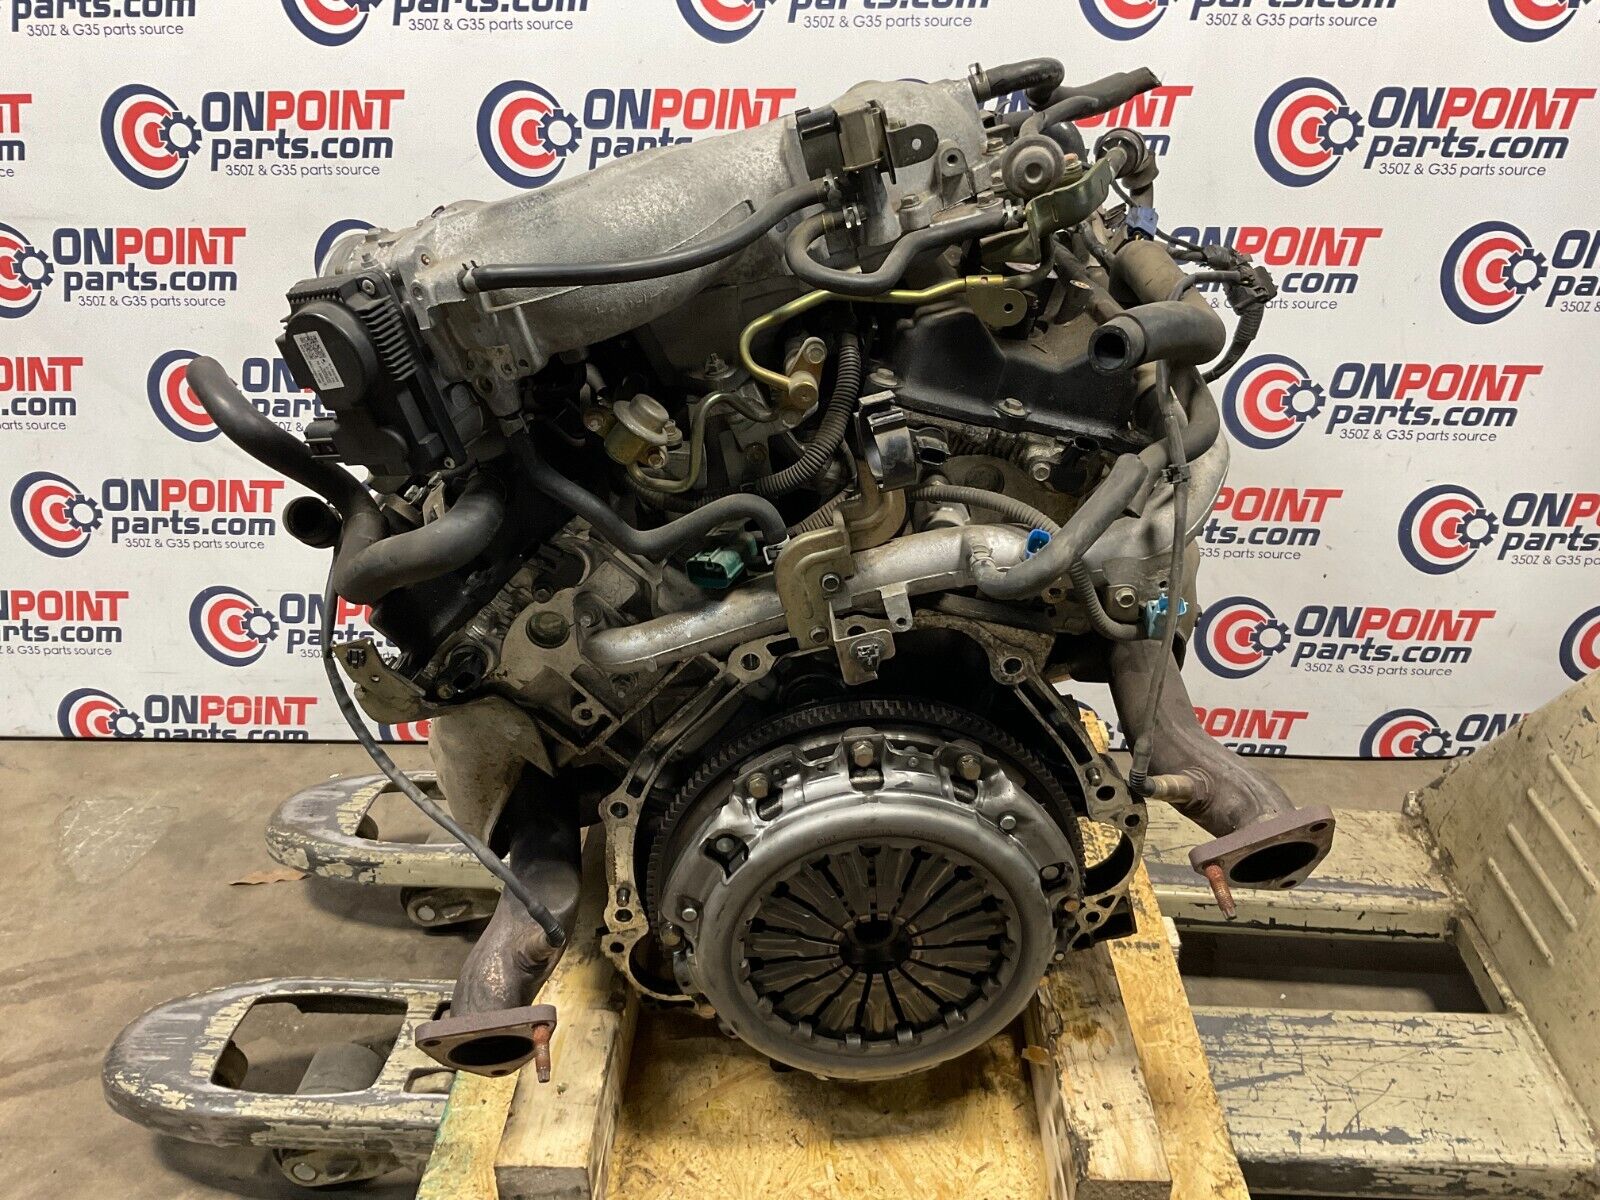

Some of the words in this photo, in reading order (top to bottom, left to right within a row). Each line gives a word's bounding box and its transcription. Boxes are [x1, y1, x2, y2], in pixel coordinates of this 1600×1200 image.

[27, 24, 56, 36] 350Z
[60, 25, 69, 35] &
[73, 24, 99, 35] G35
[103, 23, 136, 37] parts
[140, 25, 183, 34] source
[409, 19, 439, 30] 350Z
[443, 19, 453, 30] &
[457, 18, 485, 30] G35
[489, 18, 523, 32] parts
[527, 20, 573, 30] source
[804, 16, 834, 28] 350Z
[839, 16, 849, 27] &
[853, 15, 881, 27] G35
[886, 14, 920, 29] parts
[925, 17, 972, 27] source
[1206, 13, 1238, 25] 350Z
[1241, 14, 1251, 26] &
[1256, 14, 1285, 26] G35
[1289, 14, 1324, 28] parts
[1329, 17, 1377, 26] source
[201, 89, 405, 132] ONPOINT
[583, 88, 797, 130] ONPOINT
[1368, 87, 1597, 130] ONPOINT
[210, 128, 393, 171] parts.com
[1363, 127, 1569, 170] parts.com
[226, 164, 254, 176] 350Z
[258, 165, 268, 176] &
[270, 164, 297, 175] G35
[301, 164, 332, 177] parts
[336, 166, 379, 175] source
[1379, 163, 1410, 174] 350Z
[1414, 163, 1424, 175] &
[1429, 163, 1457, 175] G35
[1460, 164, 1495, 178] parts
[1499, 167, 1546, 176] source
[52, 227, 246, 265] ONPOINT
[63, 262, 238, 302] parts.com
[78, 296, 106, 306] 350Z
[109, 295, 119, 307] &
[122, 296, 147, 306] G35
[151, 296, 181, 308] parts
[184, 298, 225, 306] source
[1264, 298, 1288, 309] arts
[1292, 301, 1337, 309] source
[1560, 301, 1591, 312] 350Z
[1329, 362, 1544, 401] ONPOINT
[0, 421, 23, 430] arts
[26, 422, 66, 430] source
[1325, 397, 1518, 435] parts.com
[1340, 429, 1369, 439] 350Z
[1373, 429, 1382, 440] &
[1387, 430, 1413, 440] G35
[1416, 431, 1449, 442] parts
[1452, 433, 1496, 441] source
[102, 478, 285, 513] ONPOINT
[1212, 487, 1344, 523] POINT
[112, 509, 276, 544] parts.com
[1204, 518, 1320, 546] ts.com
[125, 538, 151, 547] 350Z
[155, 538, 163, 548] &
[166, 539, 190, 548] G35
[193, 539, 222, 549] parts
[225, 541, 264, 549] source
[1223, 549, 1254, 559] parts
[1258, 551, 1301, 559] source
[1511, 555, 1540, 564] 350Z
[1542, 555, 1551, 565] &
[1556, 555, 1581, 565] G35
[0, 590, 129, 621] POINT
[0, 619, 122, 642] rts.com
[1294, 605, 1497, 641] ONPOINT
[6, 646, 14, 654] &
[17, 646, 40, 654] G35
[43, 646, 71, 656] parts
[1291, 637, 1472, 667] parts.com
[1305, 662, 1333, 672] 350Z
[1336, 663, 1345, 673] &
[1349, 665, 1374, 674] G35
[1377, 666, 1407, 676] parts
[1411, 668, 1452, 676] source
[144, 694, 318, 726] ONPOINT
